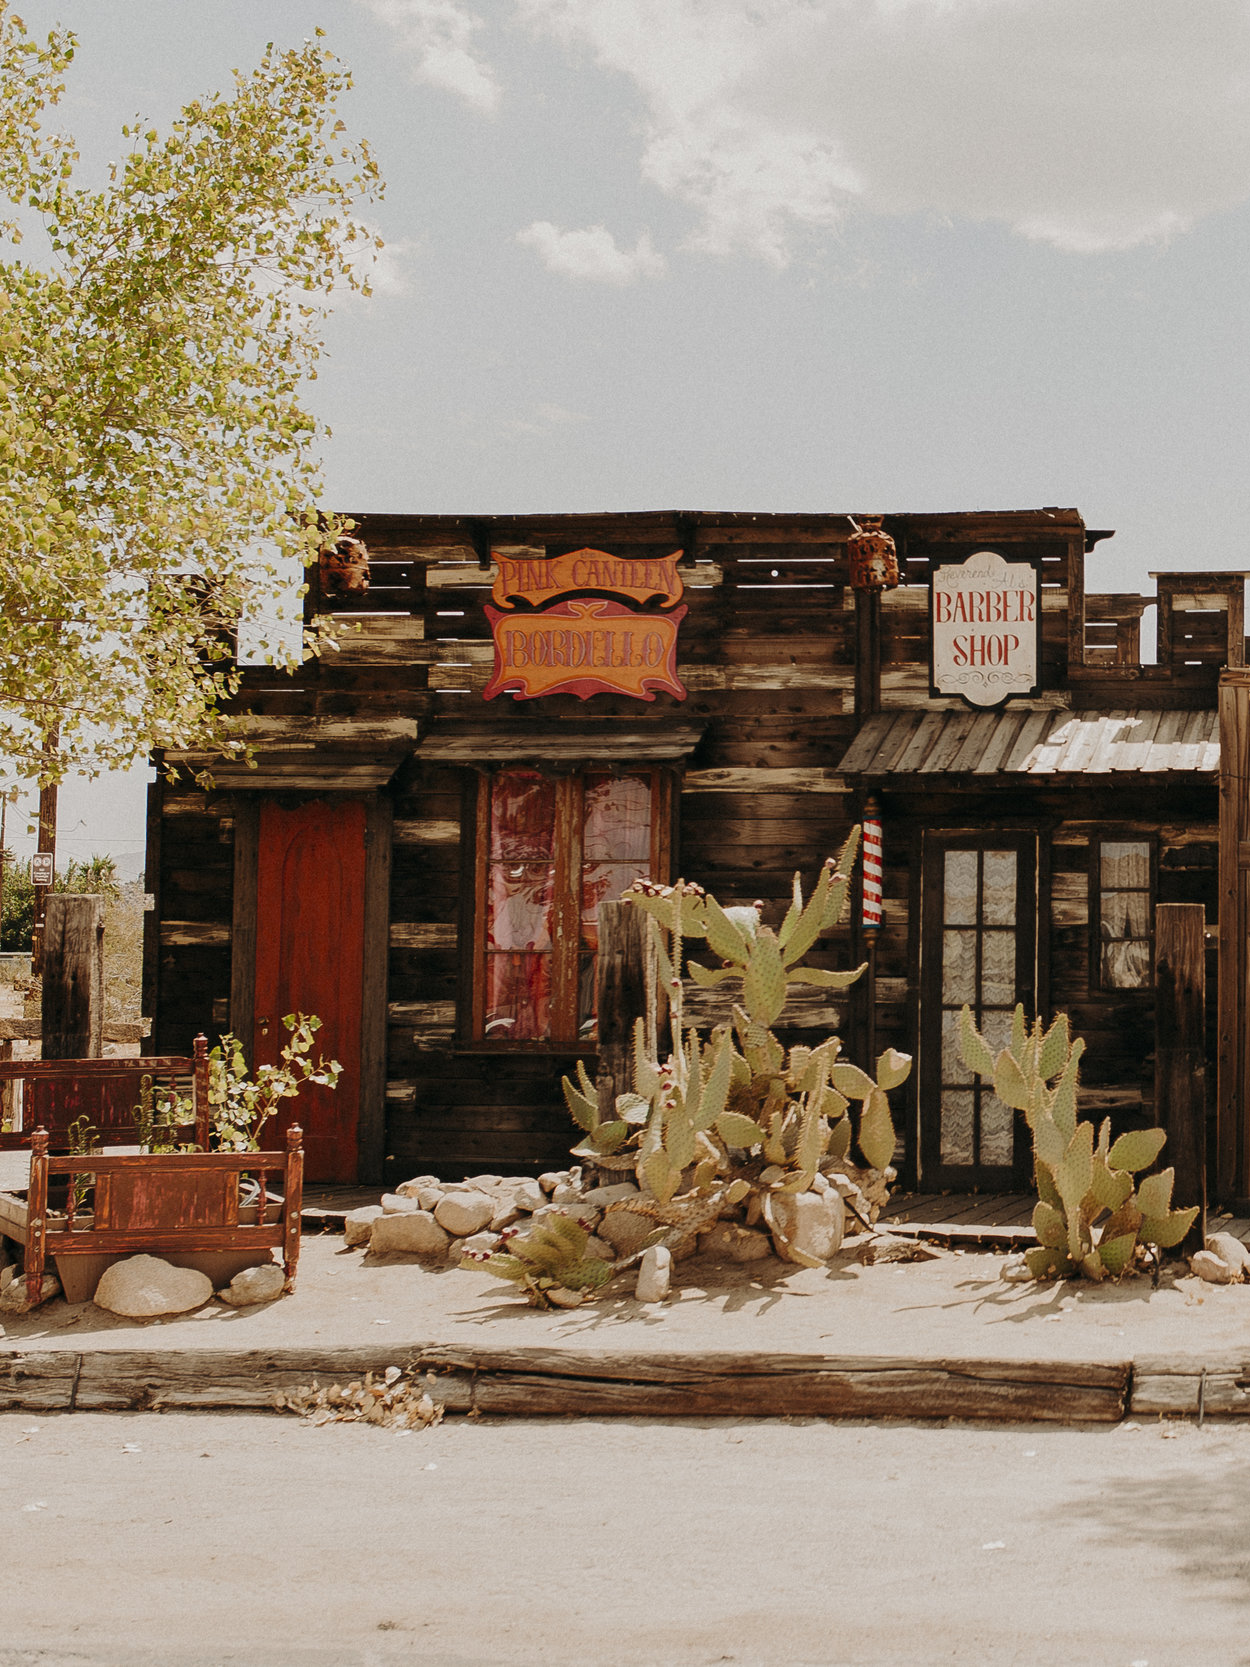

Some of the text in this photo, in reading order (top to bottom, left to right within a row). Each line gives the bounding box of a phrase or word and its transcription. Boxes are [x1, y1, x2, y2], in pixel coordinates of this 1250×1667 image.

[501, 559, 677, 597] PINK CANTEEN
[936, 590, 1035, 623] BARBER
[504, 629, 665, 668] BORDELLO
[952, 634, 1020, 667] SHOP
